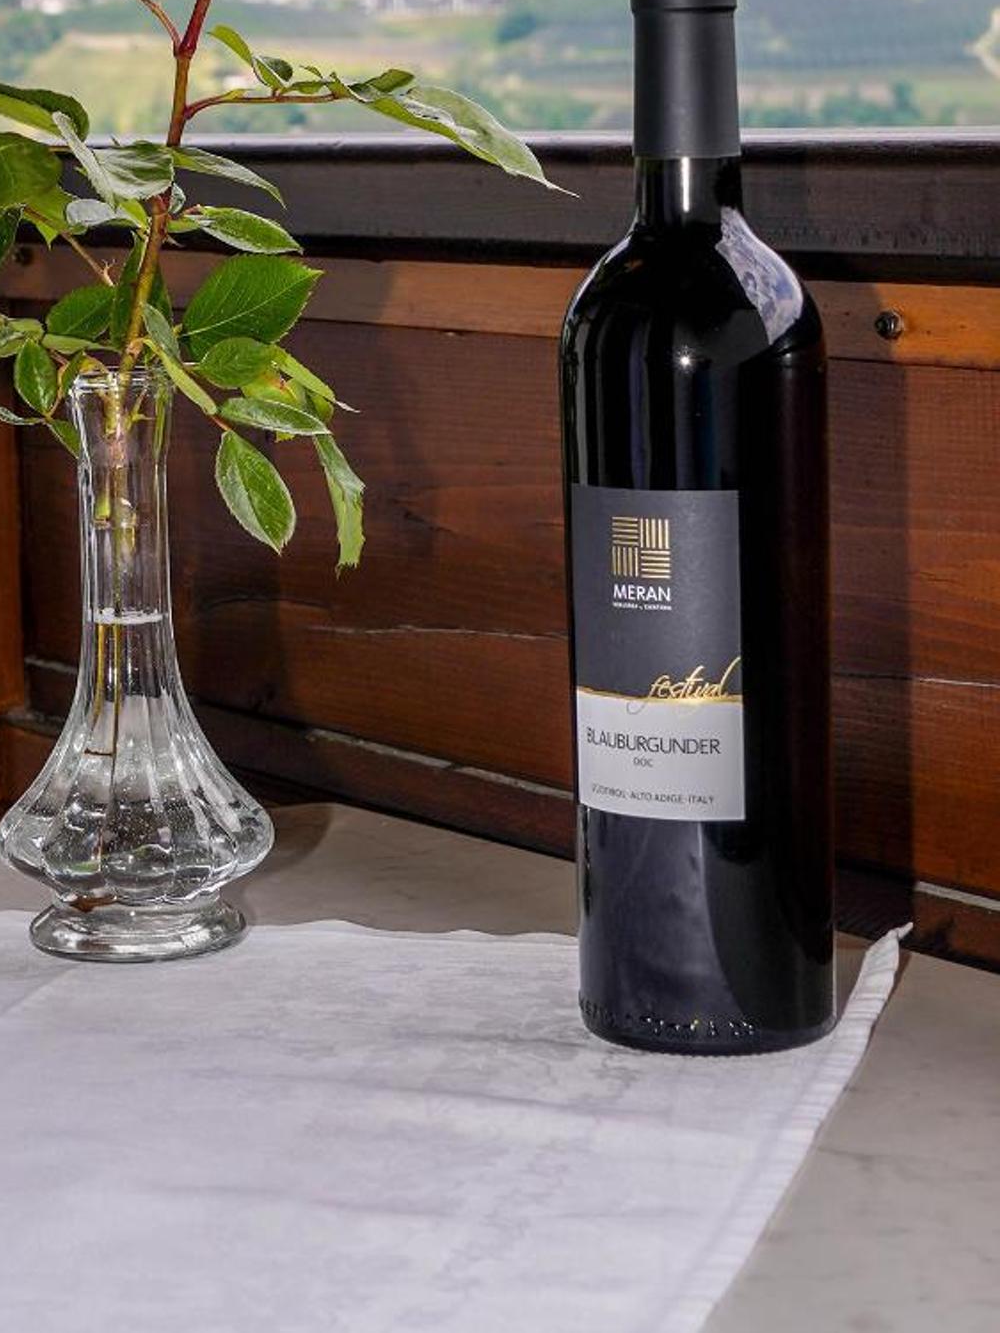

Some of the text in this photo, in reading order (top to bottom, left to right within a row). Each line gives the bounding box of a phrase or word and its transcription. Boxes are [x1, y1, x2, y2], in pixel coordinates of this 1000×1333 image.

[613, 584, 671, 602] MERAN
[586, 726, 722, 755] BLAUBURGUNDER
[633, 757, 654, 768] DOC
